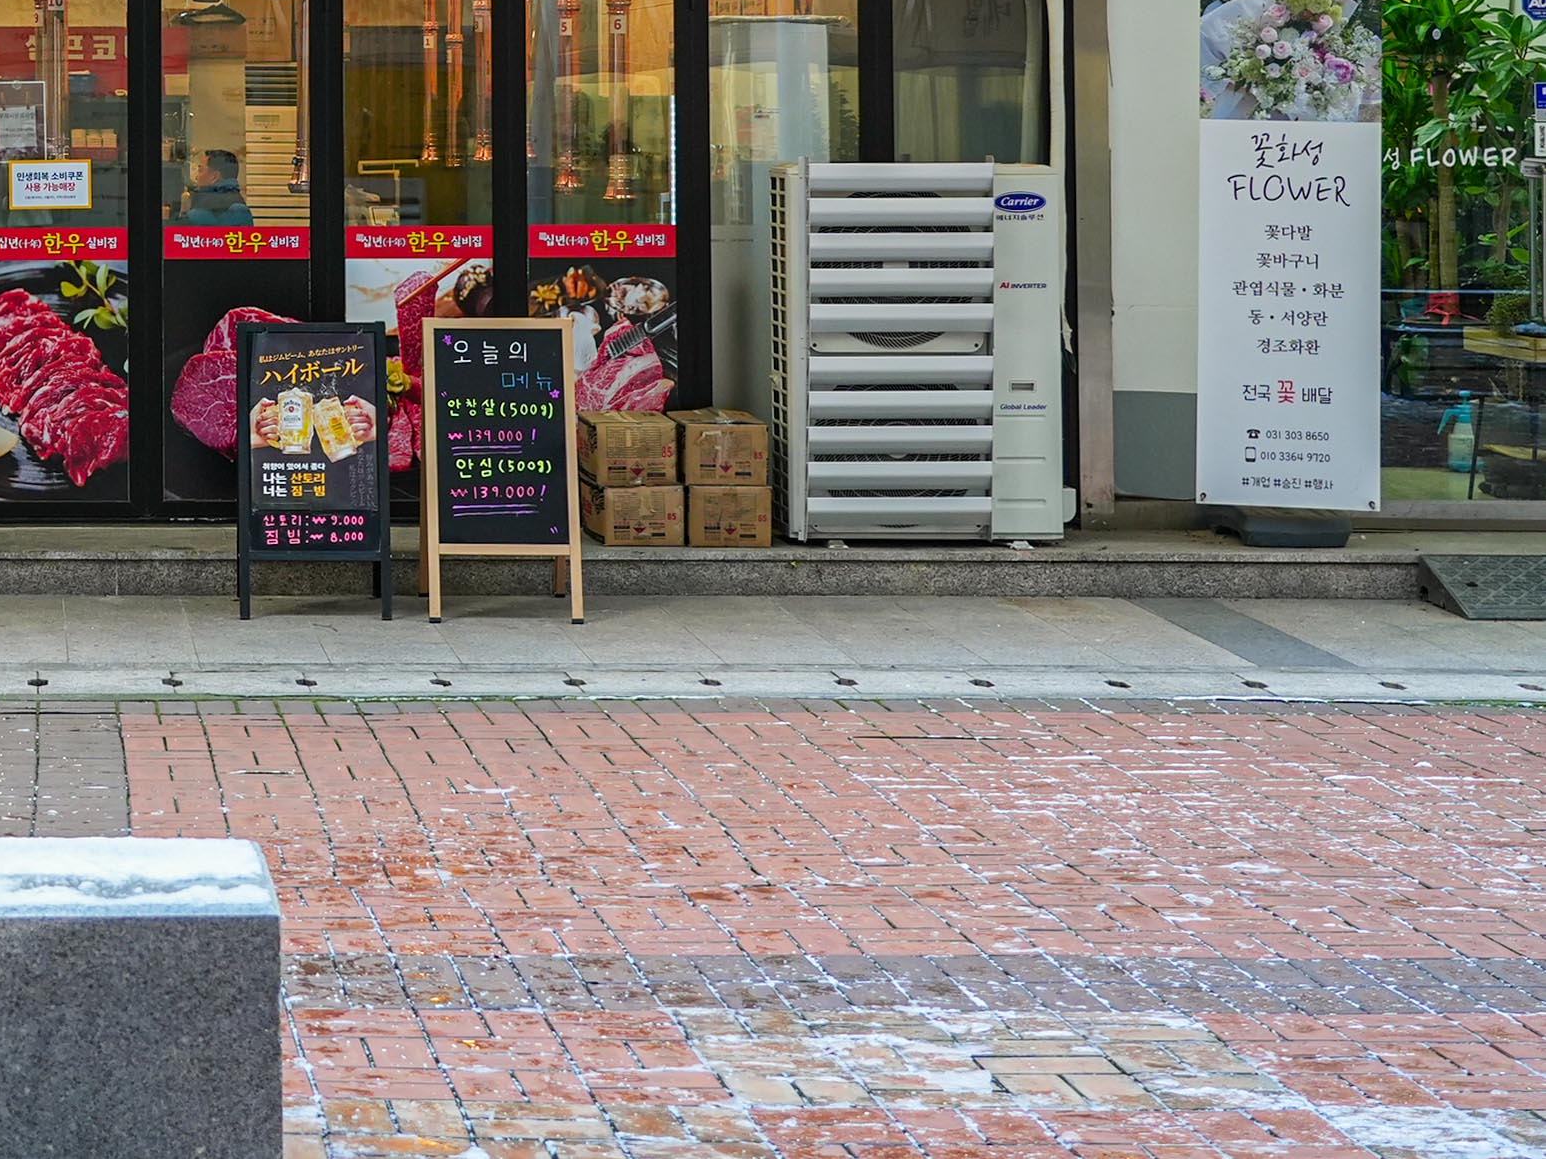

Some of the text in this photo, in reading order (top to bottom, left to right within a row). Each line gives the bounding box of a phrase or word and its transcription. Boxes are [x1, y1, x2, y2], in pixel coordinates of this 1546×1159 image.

[561, 22, 568, 32] 5
[614, 19, 622, 30] 6
[1251, 133, 1324, 168] 꽃화성
[1410, 147, 1517, 168] FLOWER
[51, 171, 83, 181] 소비쿠폰
[25, 183, 41, 192] 사용
[1227, 174, 1350, 207] FLOWER
[1000, 196, 1040, 206] Carrier
[590, 229, 633, 251] 한우
[634, 233, 666, 246] 실비집
[1264, 224, 1313, 241] 꽃다발
[43, 232, 85, 254] 한우
[86, 237, 117, 249] 실비집
[225, 231, 267, 253] 한우
[268, 235, 300, 248] 실비집
[407, 231, 449, 253] 한우
[450, 235, 482, 248] 실비집
[1256, 253, 1320, 270] 꽃바구니
[999, 281, 1010, 289] AI
[1231, 280, 1295, 297] 관엽식물
[1312, 282, 1345, 299] 화분
[1248, 309, 1264, 325] 동
[1281, 310, 1328, 327] 서양란
[454, 340, 528, 365] 오늘의
[1257, 338, 1320, 356] 경조화환
[260, 358, 365, 385] ハイボール
[502, 371, 553, 391] 메뉴
[1242, 380, 1333, 404] 전국 꽃 배달
[1266, 430, 1329, 441] 031 303 8650
[1260, 451, 1331, 463] 010 3364 9720
[262, 472, 326, 485] 나는 산토리
[262, 485, 288, 497] 너는
